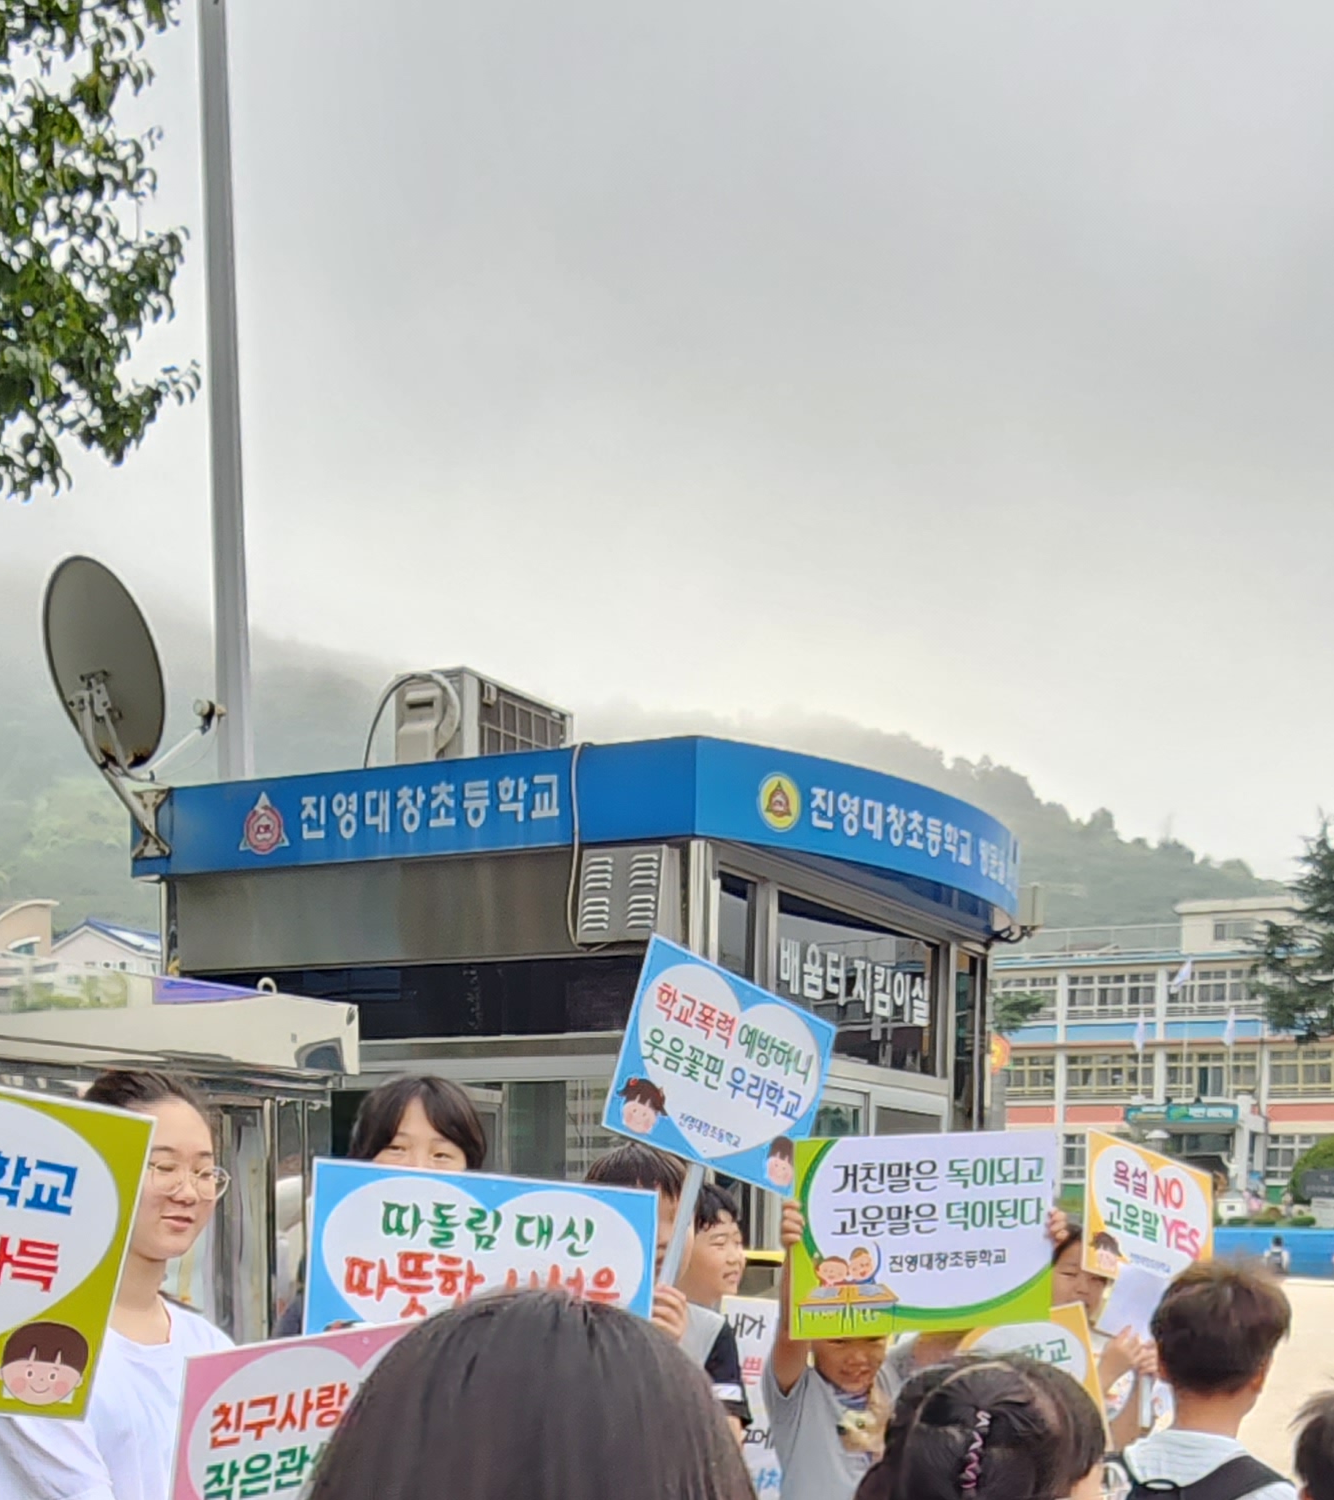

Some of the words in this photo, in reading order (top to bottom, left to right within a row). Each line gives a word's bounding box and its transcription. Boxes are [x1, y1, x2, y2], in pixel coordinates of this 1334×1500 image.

[300, 774, 560, 840] 진영대창초등학교
[810, 787, 972, 866] 진영대창초등학교
[779, 938, 846, 1006] 배움터
[656, 983, 736, 1048] 학교폭력
[738, 1024, 814, 1084] 예방하니
[642, 1028, 724, 1090] 웃음꽃핀
[726, 1067, 802, 1121] 우리학교
[679, 1113, 741, 1148] 진영대창초등학교
[832, 1160, 939, 1194] 거친말은
[945, 1157, 1044, 1189] 독이되고
[1114, 1160, 1148, 1200] 욕설
[1154, 1175, 1184, 1210] NO
[381, 1201, 502, 1250] 따돌림
[515, 1213, 594, 1256] 대신
[831, 1203, 939, 1237] 고운말은
[946, 1197, 1044, 1231] 덕이된다
[1104, 1197, 1159, 1243] 고운말
[1162, 1215, 1201, 1260] YES
[889, 1249, 1006, 1273] 진영대창초등학교
[210, 1382, 350, 1450] 친구사랑
